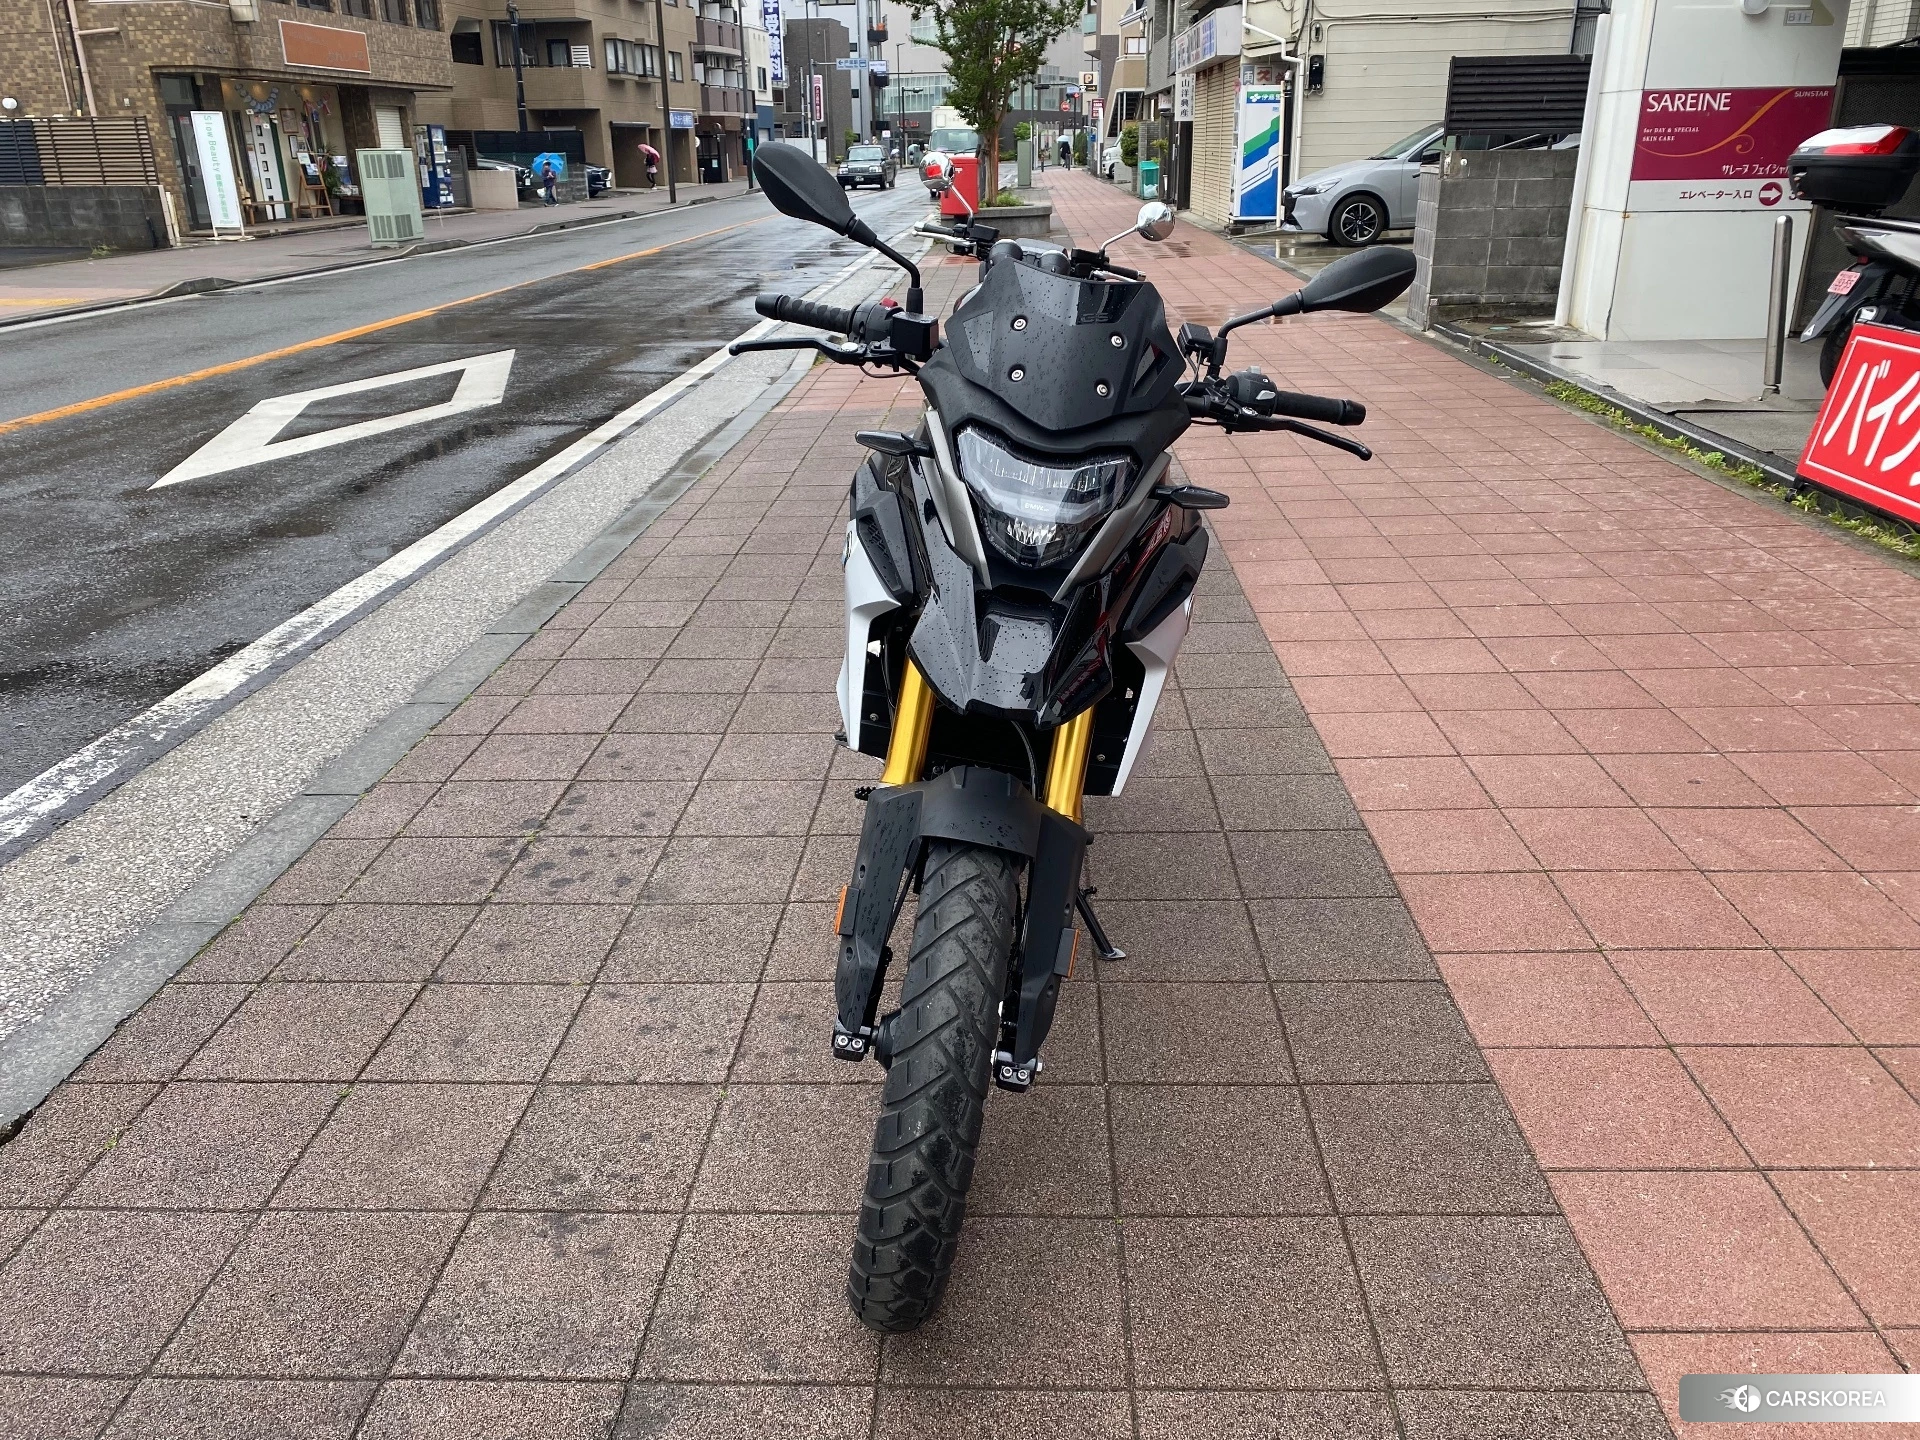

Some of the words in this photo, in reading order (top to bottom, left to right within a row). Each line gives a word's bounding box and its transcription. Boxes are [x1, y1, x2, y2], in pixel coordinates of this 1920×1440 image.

[1794, 90, 1829, 98] SUNSTAR
[1646, 92, 1732, 113] SAREINE
[208, 140, 221, 172] Beauty
[1722, 163, 1750, 176] サレーヌ
[1679, 189, 1753, 200] エレベーター入口
